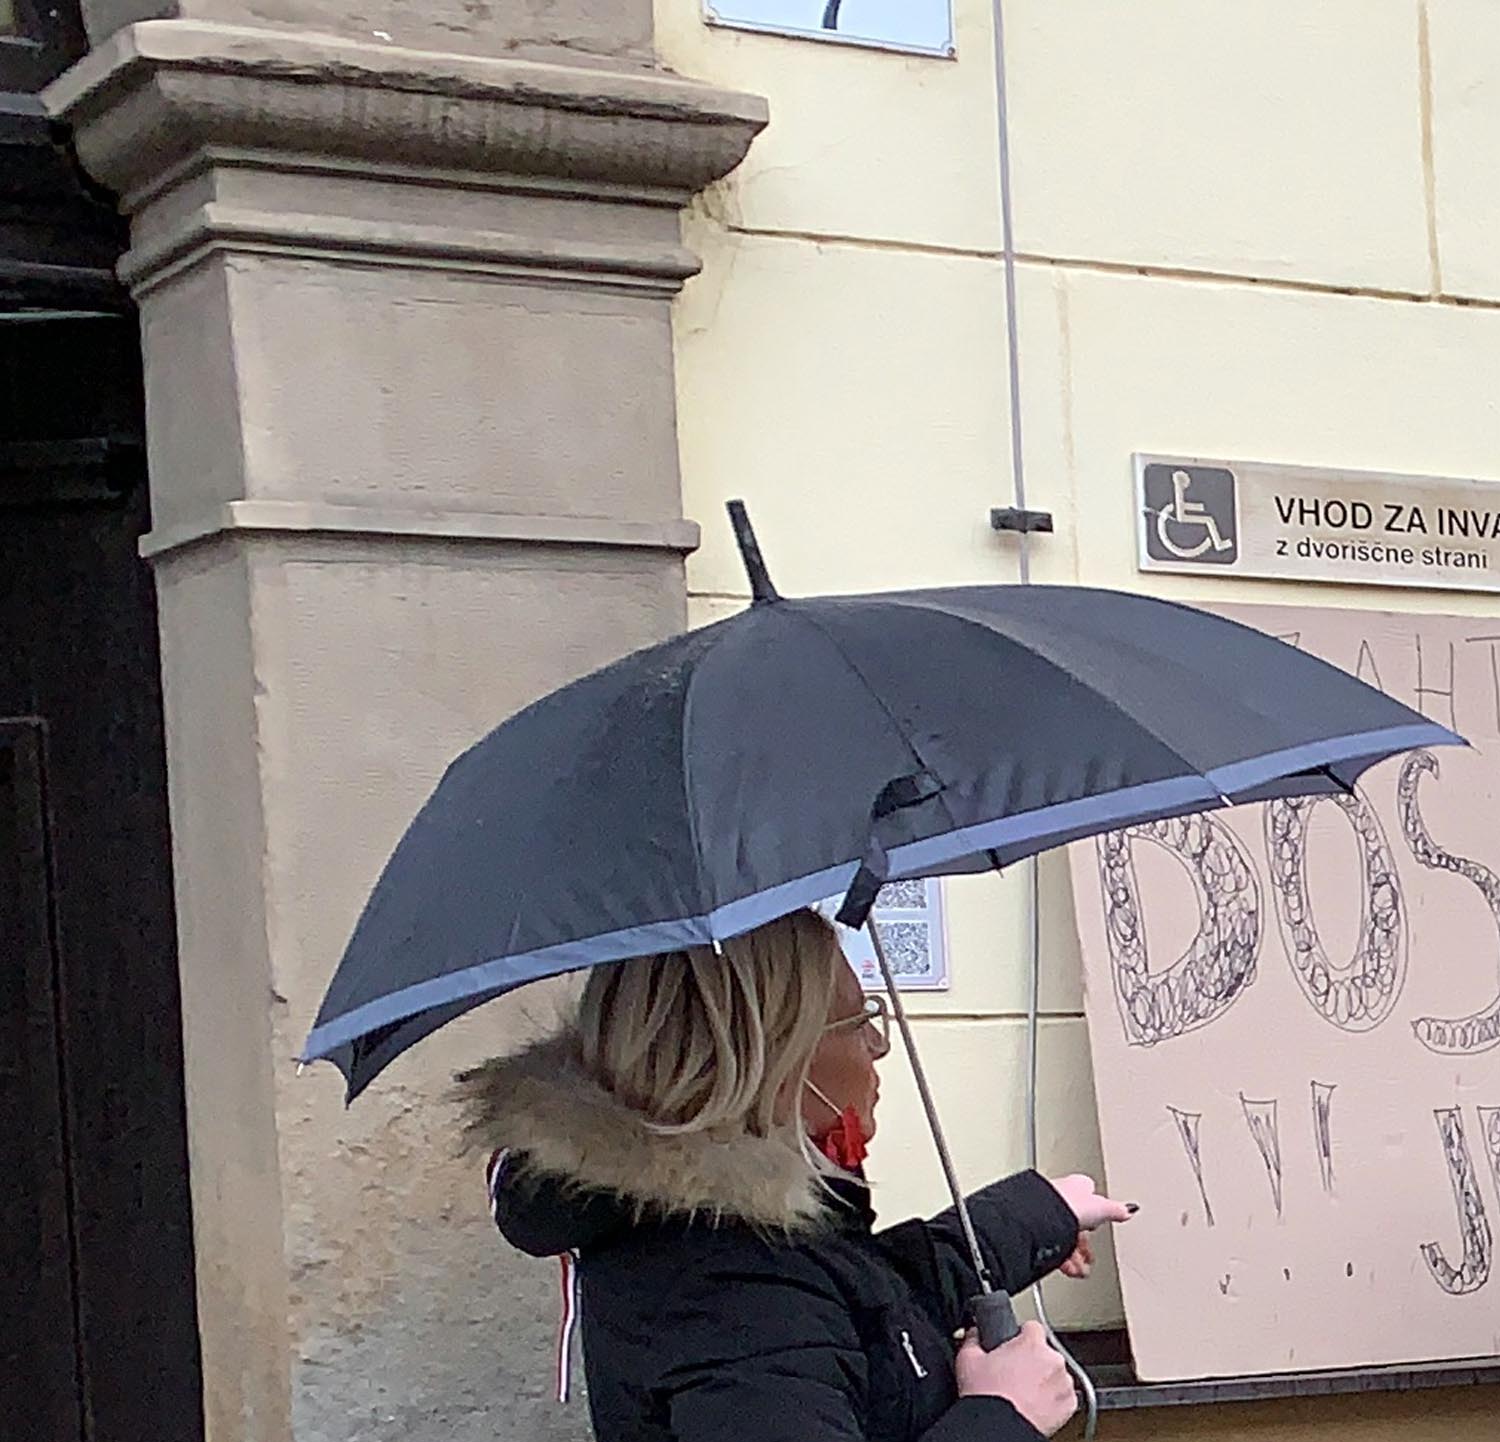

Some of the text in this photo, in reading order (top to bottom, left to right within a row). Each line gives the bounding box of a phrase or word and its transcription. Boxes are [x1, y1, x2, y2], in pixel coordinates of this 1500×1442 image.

[1274, 496, 1372, 530] VHOD
[1384, 503, 1427, 534] ZA
[1276, 536, 1488, 569] z dvoriščne strani
